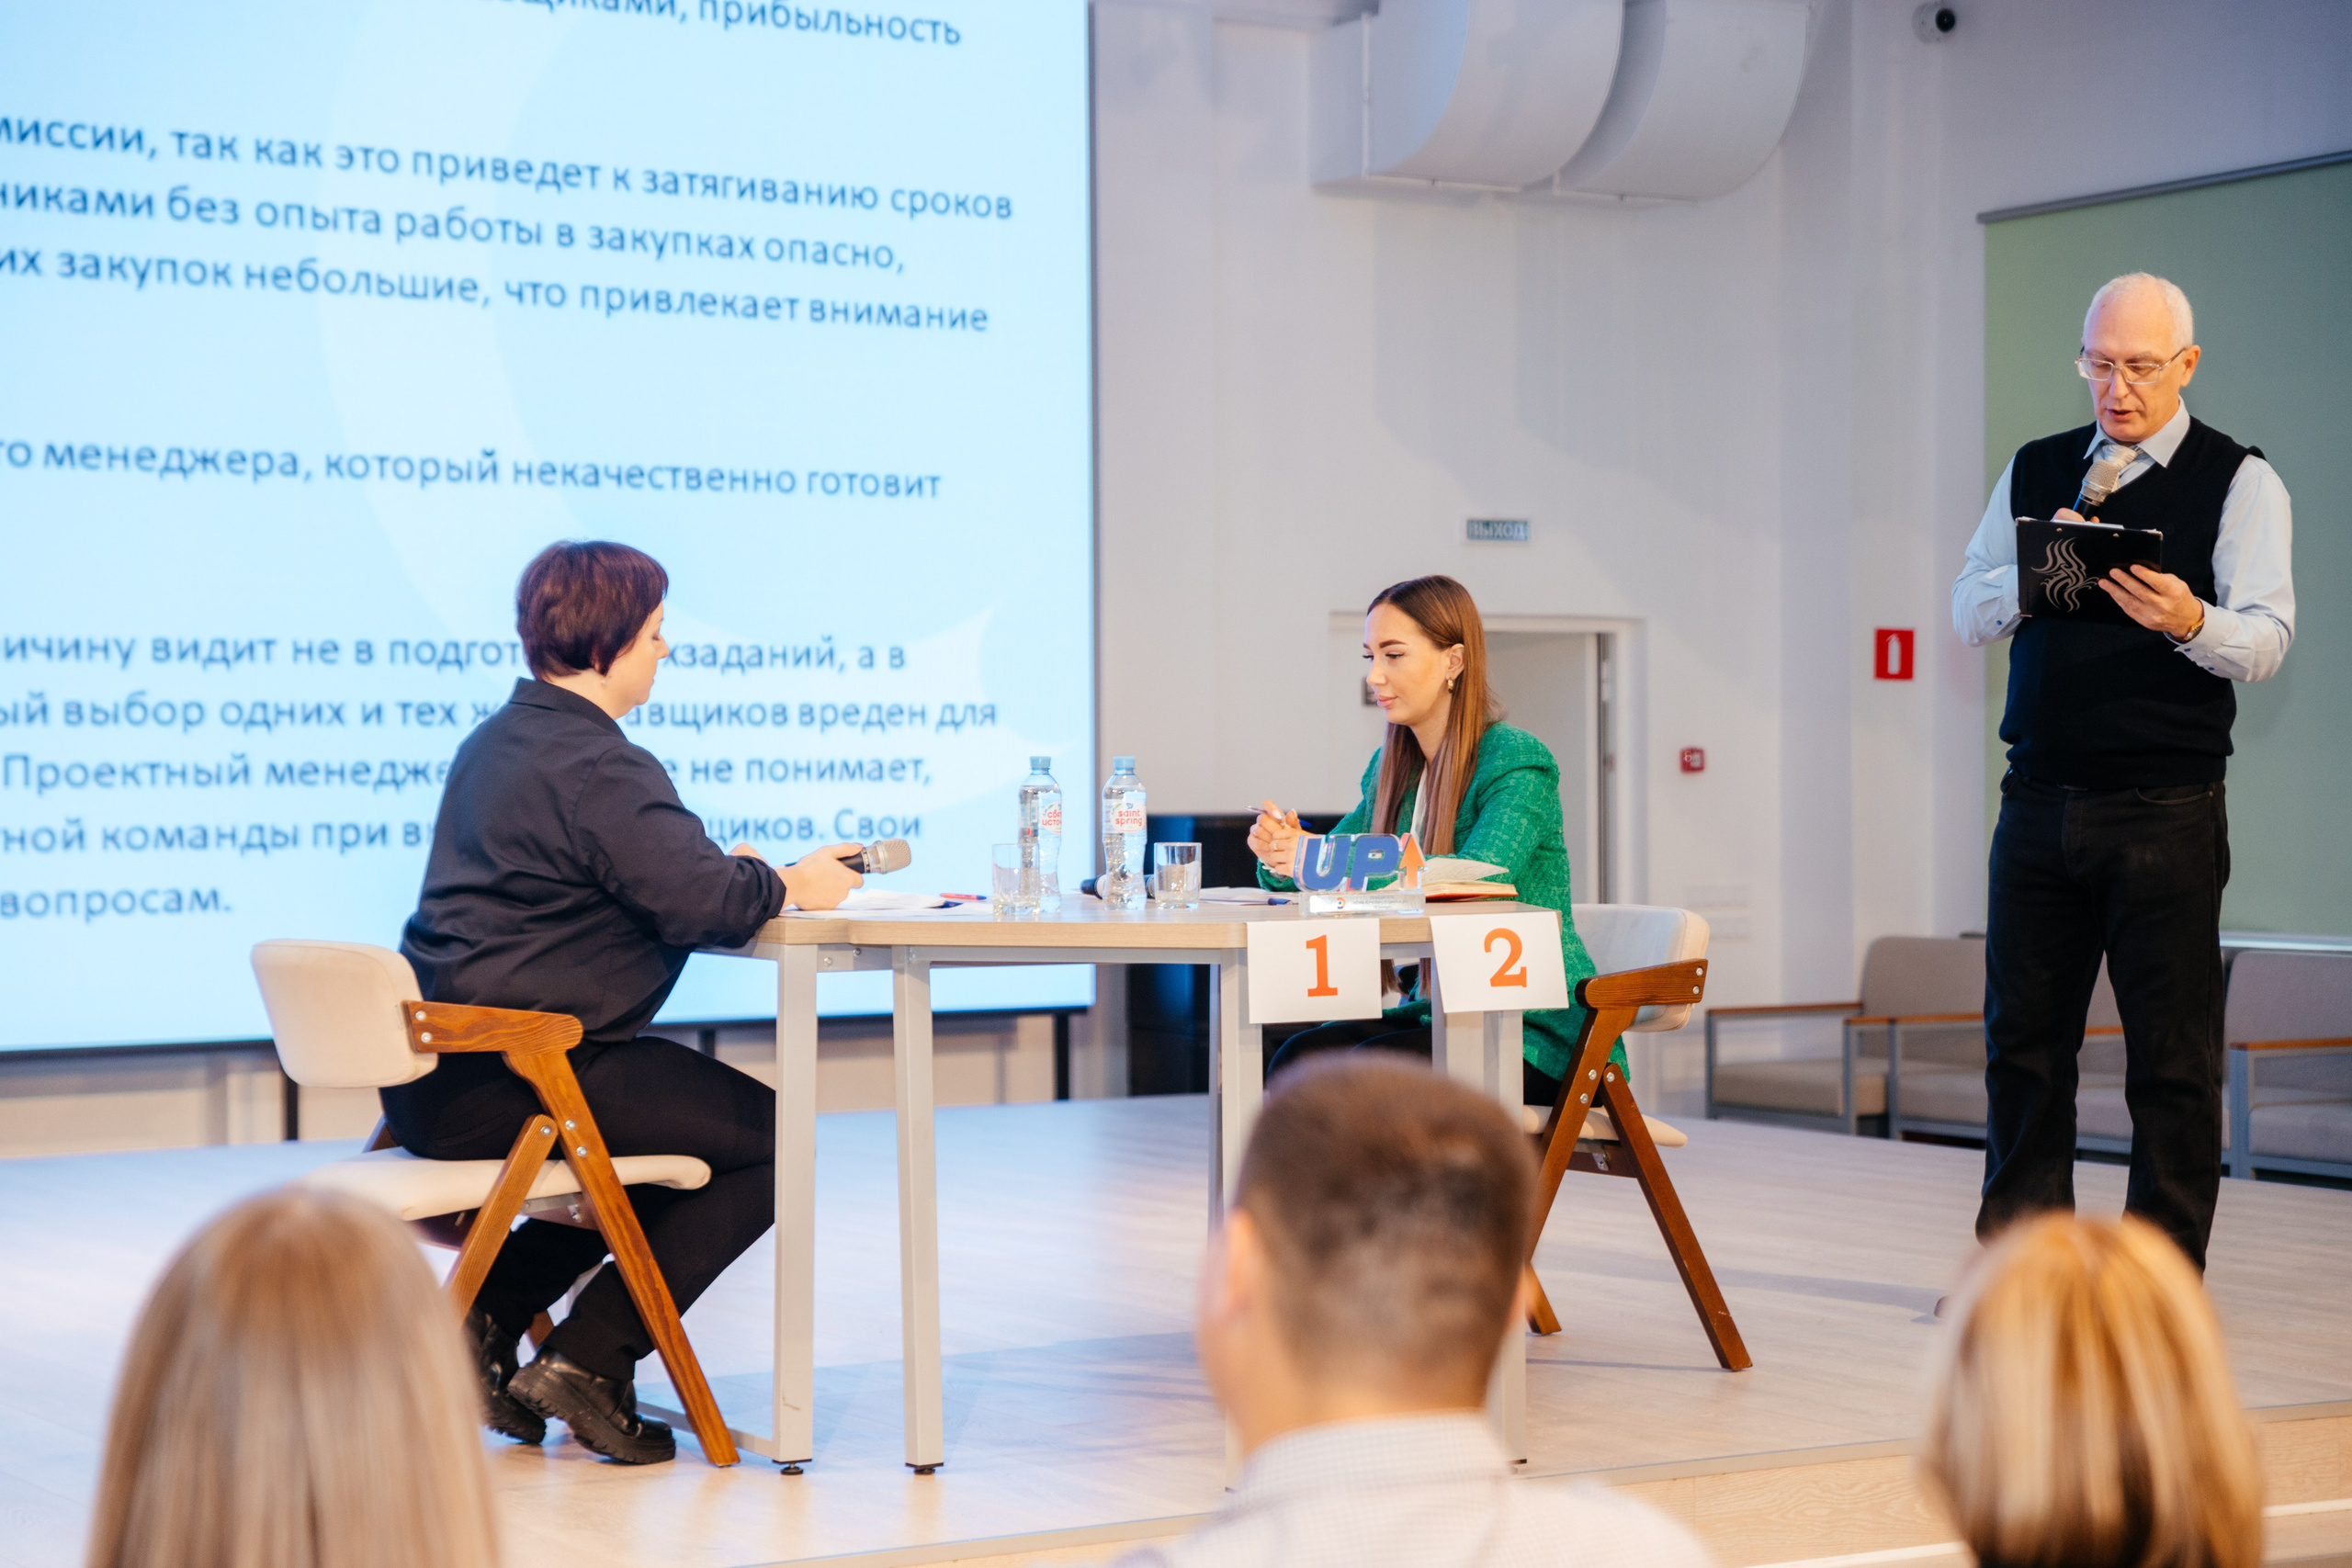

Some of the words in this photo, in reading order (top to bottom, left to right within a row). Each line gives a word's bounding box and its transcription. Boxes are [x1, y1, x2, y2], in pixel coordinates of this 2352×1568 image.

[698, 0, 962, 46] прибыльность
[170, 130, 239, 162] так
[254, 138, 322, 168] как
[335, 144, 401, 175] это
[413, 151, 602, 195] приведет
[613, 167, 631, 192] к
[642, 169, 879, 210] затягиванию
[889, 188, 1013, 221] сроков
[0, 182, 154, 218] иками
[166, 185, 241, 226] без
[254, 200, 382, 235] опыта
[395, 205, 544, 246] работы
[556, 223, 576, 248] в
[588, 225, 755, 262] закупках
[763, 237, 904, 275] опасно,
[57, 251, 232, 291] закупок
[243, 256, 491, 308] небольшие,
[504, 280, 568, 309] что
[580, 285, 800, 321] привлекает
[808, 299, 989, 333] внимание
[42, 442, 312, 484] менеджера,
[324, 447, 500, 490] который
[513, 460, 797, 495] некачественно
[807, 470, 942, 499] готовит
[151, 637, 277, 671] видит
[292, 638, 341, 665] не
[354, 639, 375, 666] в
[857, 644, 876, 670] а
[888, 645, 906, 671] в
[62, 689, 207, 734] выбор
[220, 700, 346, 734] одних
[361, 703, 384, 726] и
[396, 701, 458, 728] тех
[797, 702, 928, 735] вреден
[934, 702, 999, 734] для
[2, 751, 252, 797] Проектный
[690, 759, 735, 784] не
[745, 758, 931, 785] понимает,
[102, 823, 300, 857] команды
[312, 822, 390, 855] при
[832, 807, 922, 840] Свои
[1114, 817, 1143, 827] spring
[1117, 809, 1141, 818] saint
[1300, 835, 1400, 890] UP
[0, 886, 232, 924] вопросам.
[1305, 934, 1339, 998] 1
[1484, 928, 1528, 988] 2
